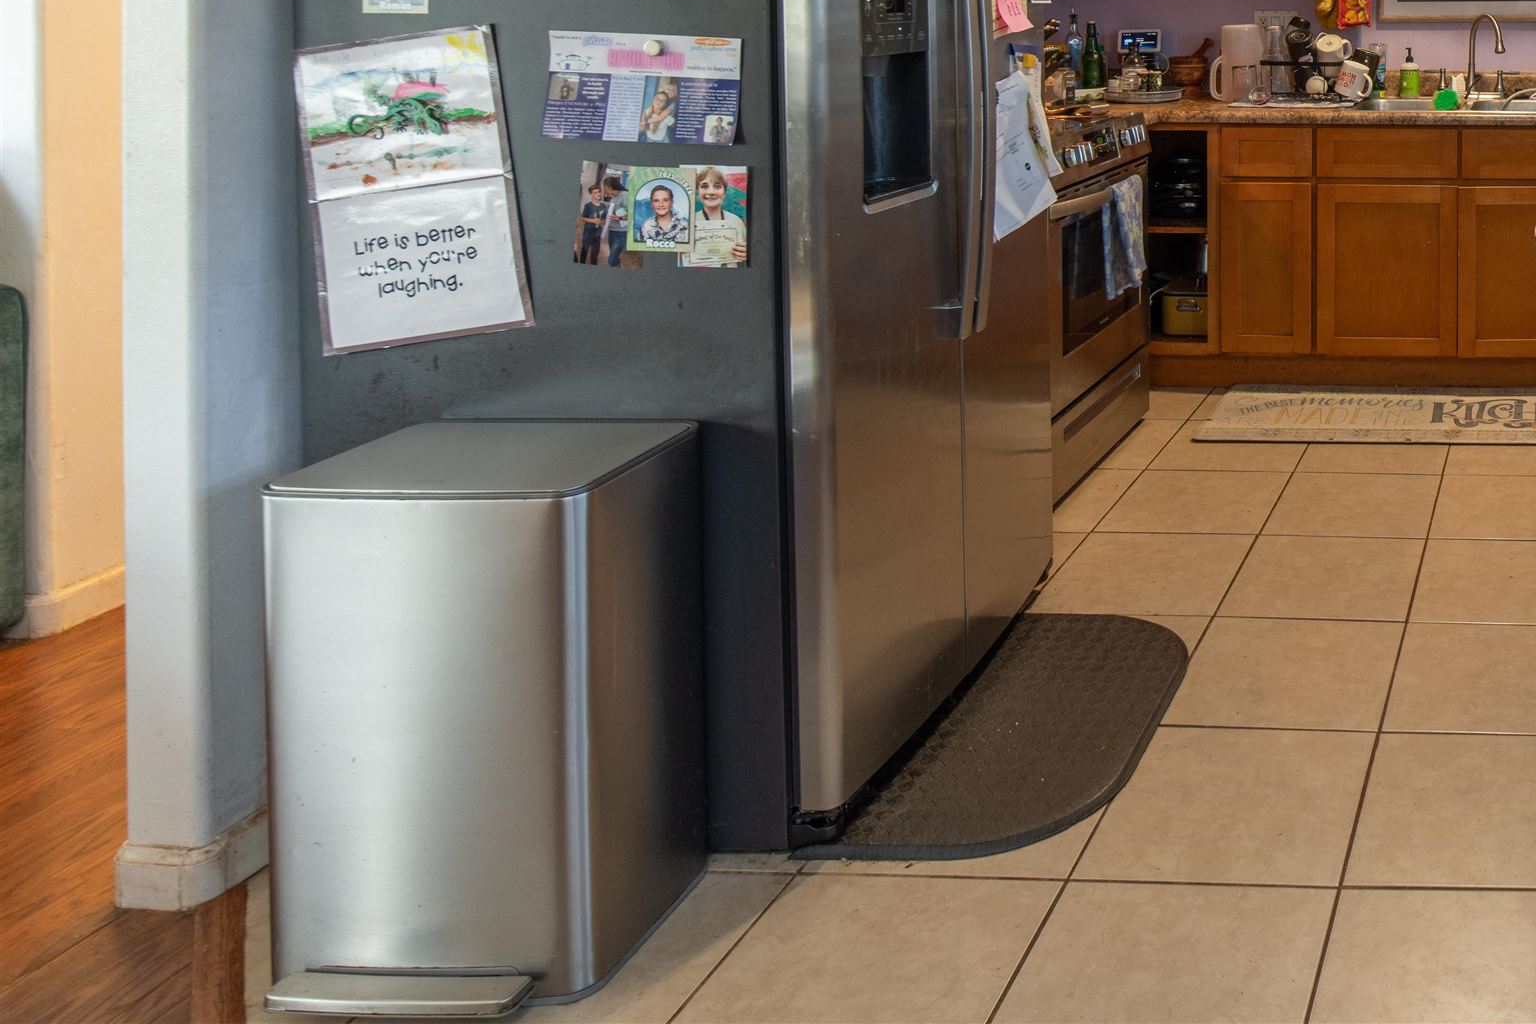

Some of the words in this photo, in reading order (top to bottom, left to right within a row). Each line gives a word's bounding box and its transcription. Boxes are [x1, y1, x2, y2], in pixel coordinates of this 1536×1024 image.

[353, 235, 389, 256] Life
[394, 233, 410, 250] is
[415, 225, 476, 247] better
[645, 238, 676, 249] Rocco
[358, 257, 412, 277] when
[418, 246, 478, 273] you're
[378, 274, 464, 298] laughing.
[1239, 405, 1261, 415] THE
[1264, 398, 1295, 410] BEST
[1300, 396, 1425, 412] memories
